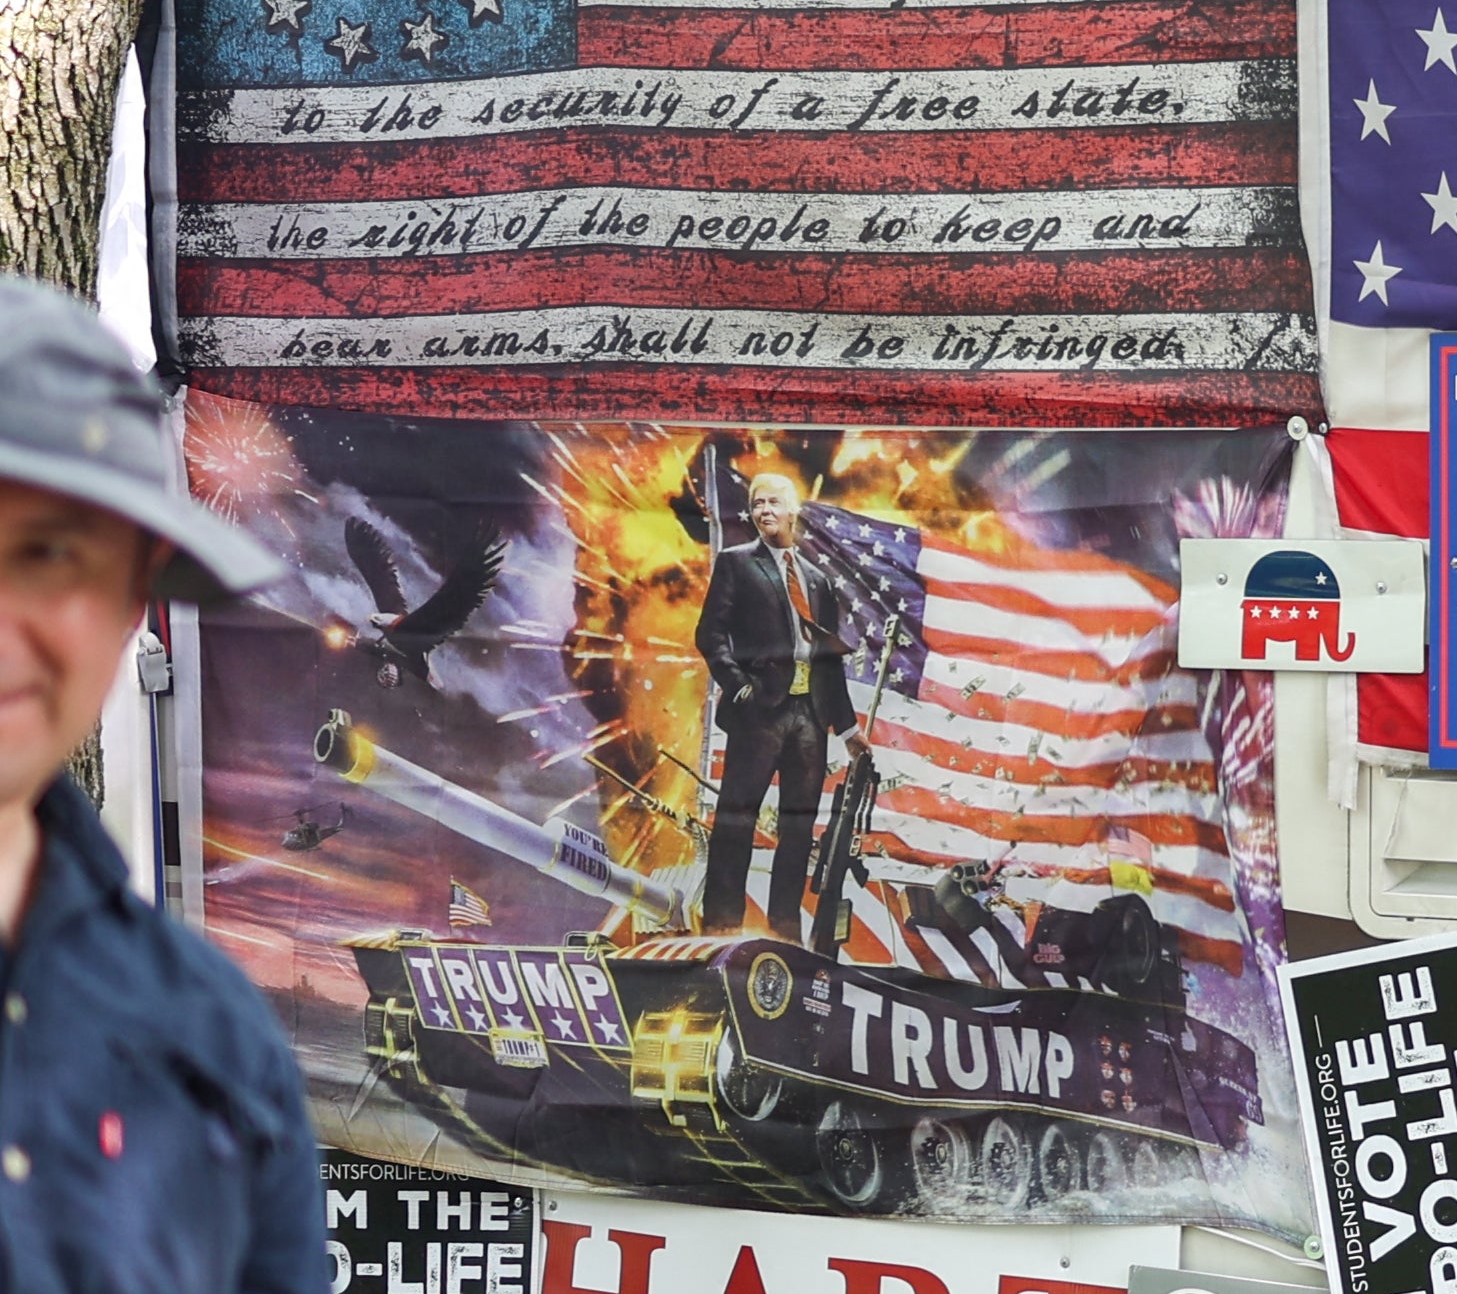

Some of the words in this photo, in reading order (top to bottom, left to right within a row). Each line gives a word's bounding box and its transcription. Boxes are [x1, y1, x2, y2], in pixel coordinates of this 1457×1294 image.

[281, 93, 326, 136] to
[360, 90, 443, 132] the
[473, 79, 682, 132] security
[709, 75, 777, 132] of
[794, 90, 825, 118] a
[850, 75, 980, 127] free
[267, 213, 326, 249] the
[350, 205, 482, 257] right
[505, 195, 564, 255] of
[582, 195, 650, 240] the
[671, 205, 829, 255] people
[861, 205, 914, 245] to
[934, 205, 1063, 255] keep
[1092, 200, 1199, 240] and
[281, 325, 391, 363] bear
[586, 317, 712, 360] shall
[740, 321, 818, 360] not
[843, 320, 905, 360] be
[560, 846, 609, 881] FIRED
[563, 824, 608, 855] YOU'RE
[409, 958, 608, 1010] TRUMP
[843, 980, 1074, 1097] TRUMP
[1315, 1054, 1368, 1292] STUDENTSFORLIFE.ORG
[1335, 1032, 1416, 1262] VOTE
[398, 1190, 511, 1231] THE
